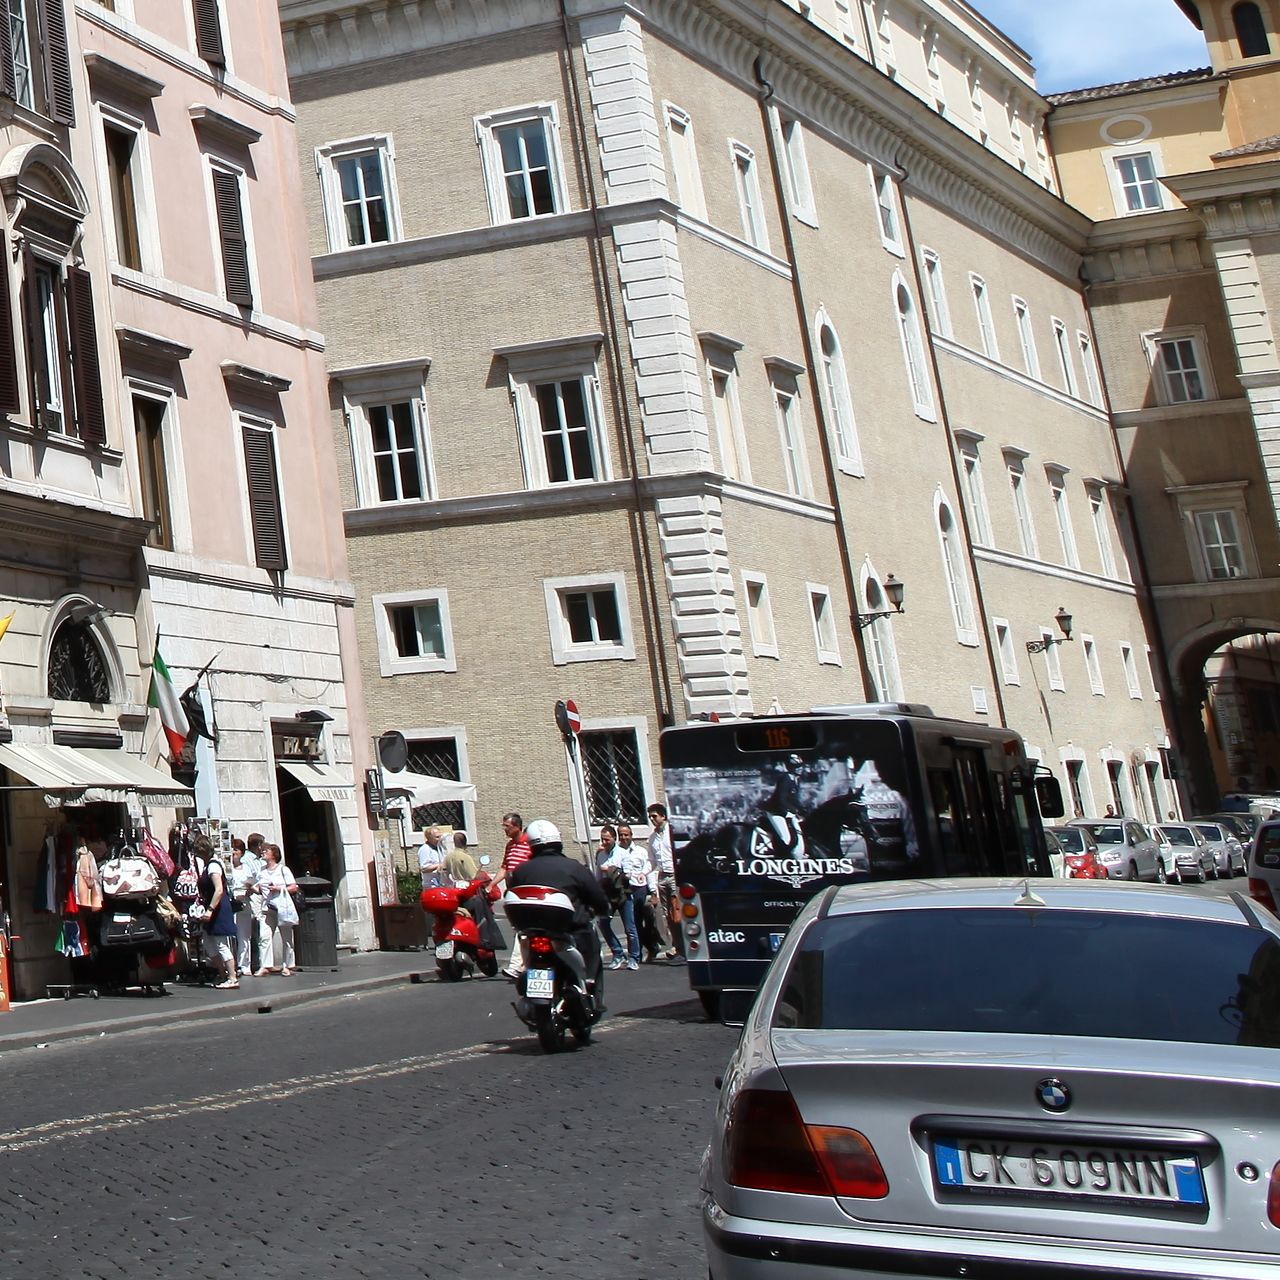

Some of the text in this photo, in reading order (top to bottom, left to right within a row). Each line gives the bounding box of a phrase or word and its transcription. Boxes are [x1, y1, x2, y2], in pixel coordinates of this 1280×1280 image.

[765, 729, 790, 748] 116
[686, 771, 717, 780] Elegance
[737, 858, 855, 876] LONGINES
[708, 928, 746, 944] atac
[965, 1144, 1017, 1185] CK
[1030, 1147, 1171, 1197] 609NN
